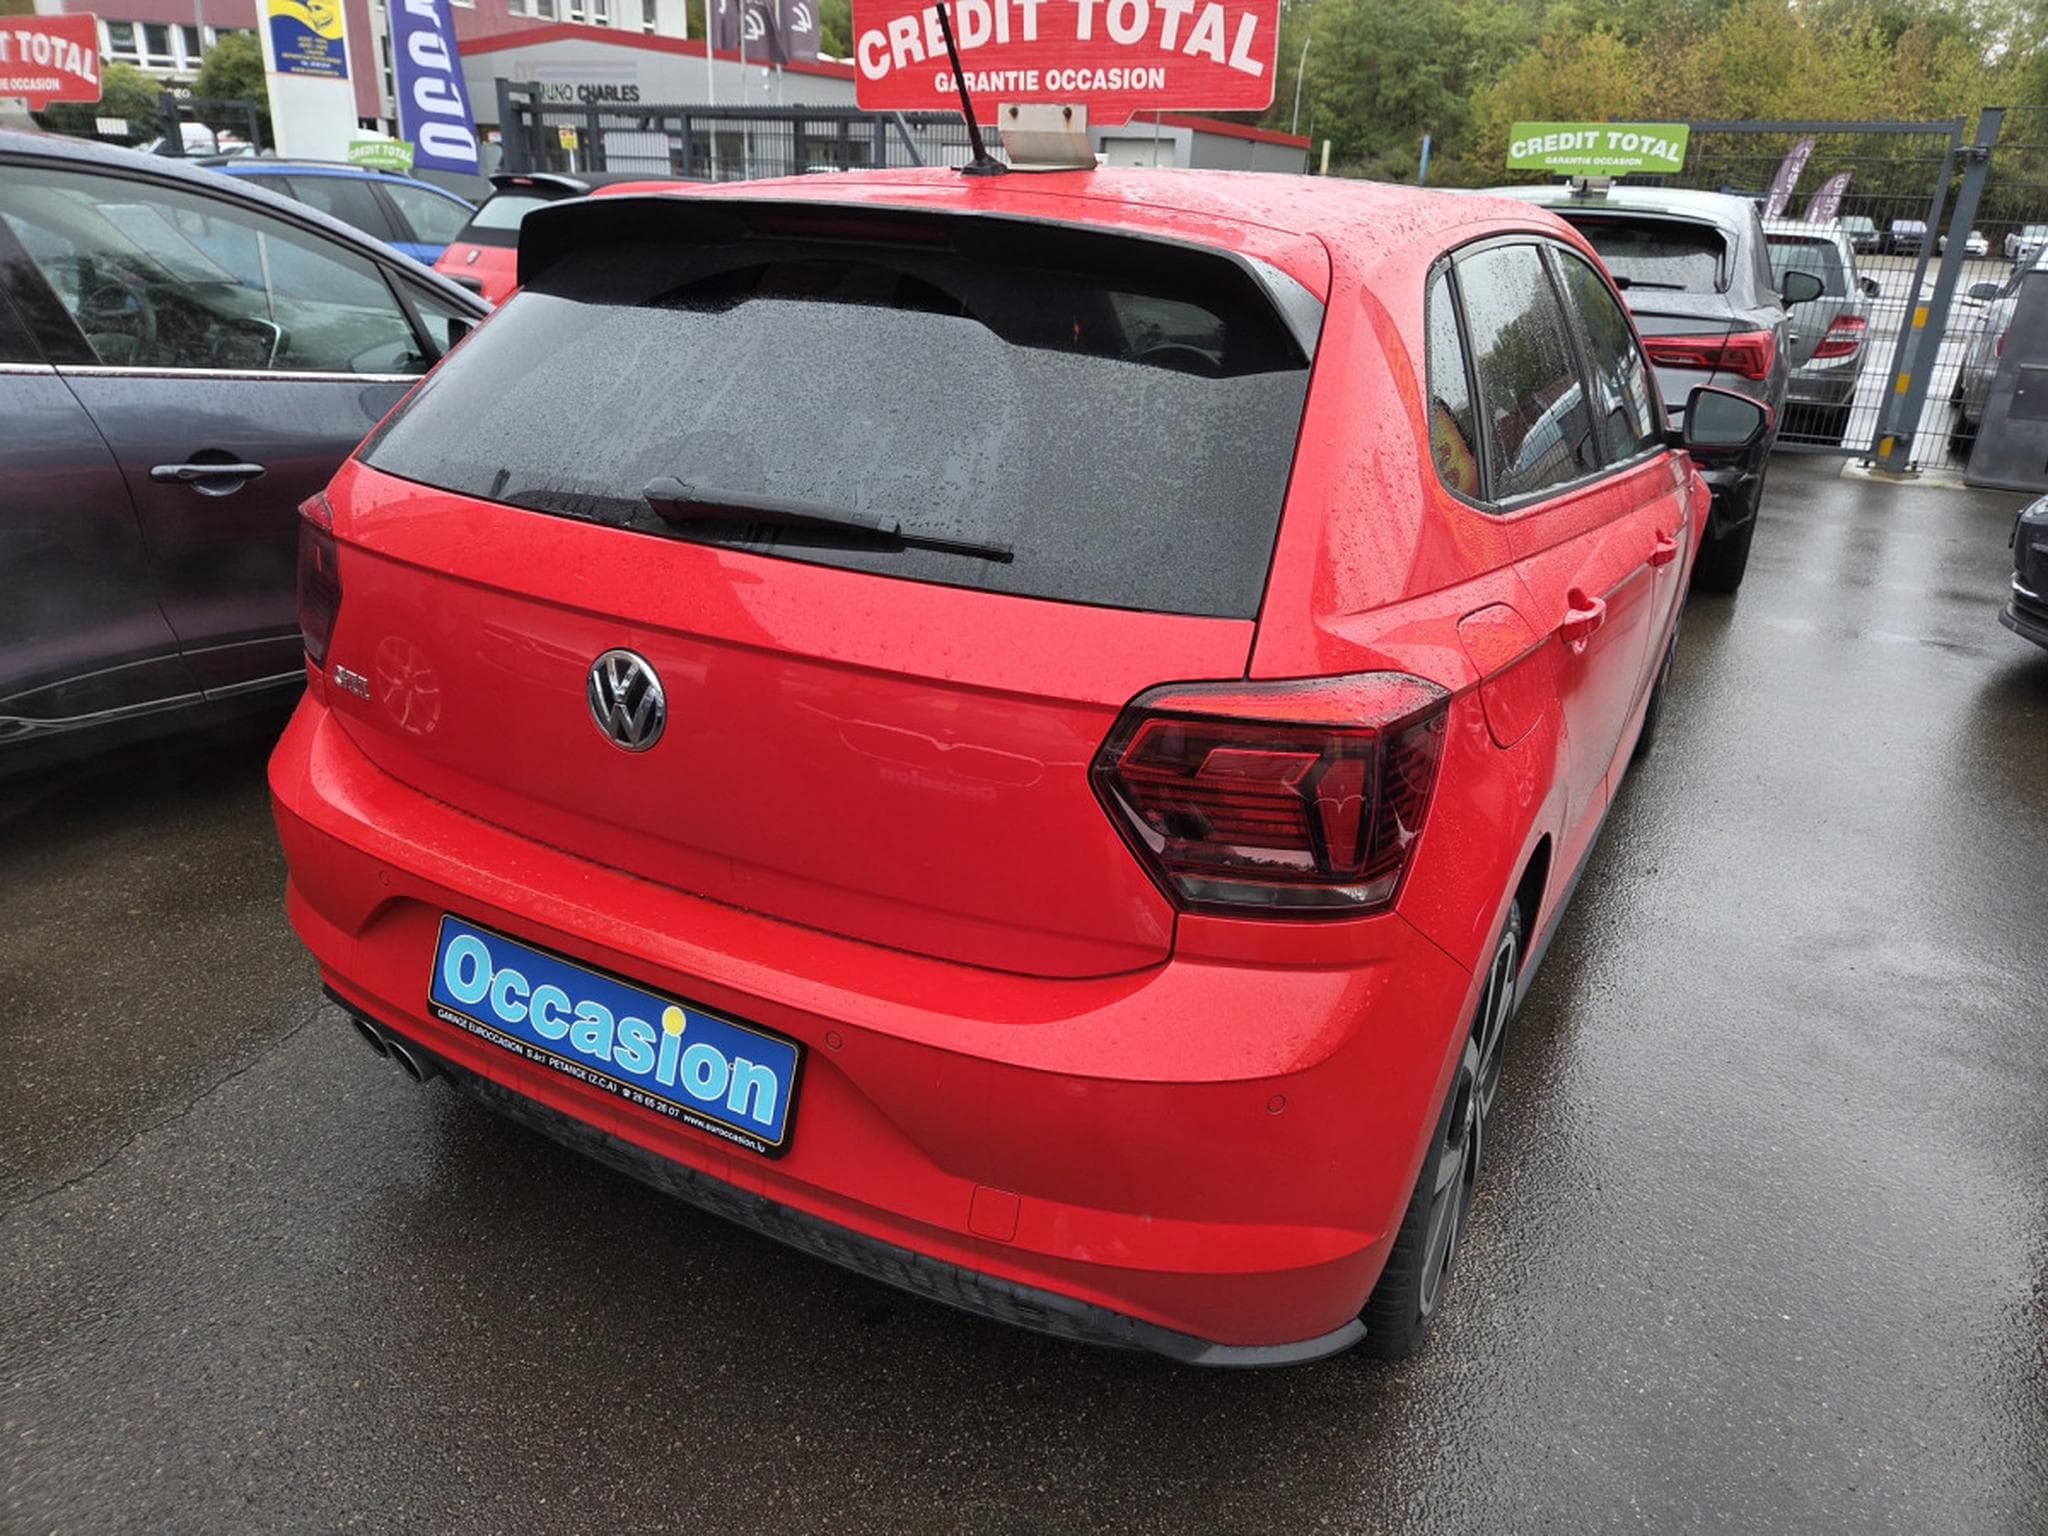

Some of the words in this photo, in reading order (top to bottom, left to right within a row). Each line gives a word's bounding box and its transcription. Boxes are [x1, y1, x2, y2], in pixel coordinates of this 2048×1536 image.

[858, 0, 1047, 80] CREDIT
[1066, 0, 1264, 77] TOTAL
[14, 29, 97, 85] TOTAL
[577, 83, 640, 101] CHARLES
[934, 70, 1039, 92] GARANTIE
[1045, 67, 1166, 91] OCCASION
[382, 144, 410, 162] TOTAL
[1510, 131, 1599, 159] CREDIT
[1607, 131, 1680, 162] TOTAL
[1545, 156, 1591, 165] GARANTIE
[1593, 156, 1643, 166] OCCASION
[443, 933, 779, 1126] Occasion
[468, 1023, 524, 1054] EUROCCASION
[668, 1106, 680, 1116] 07
